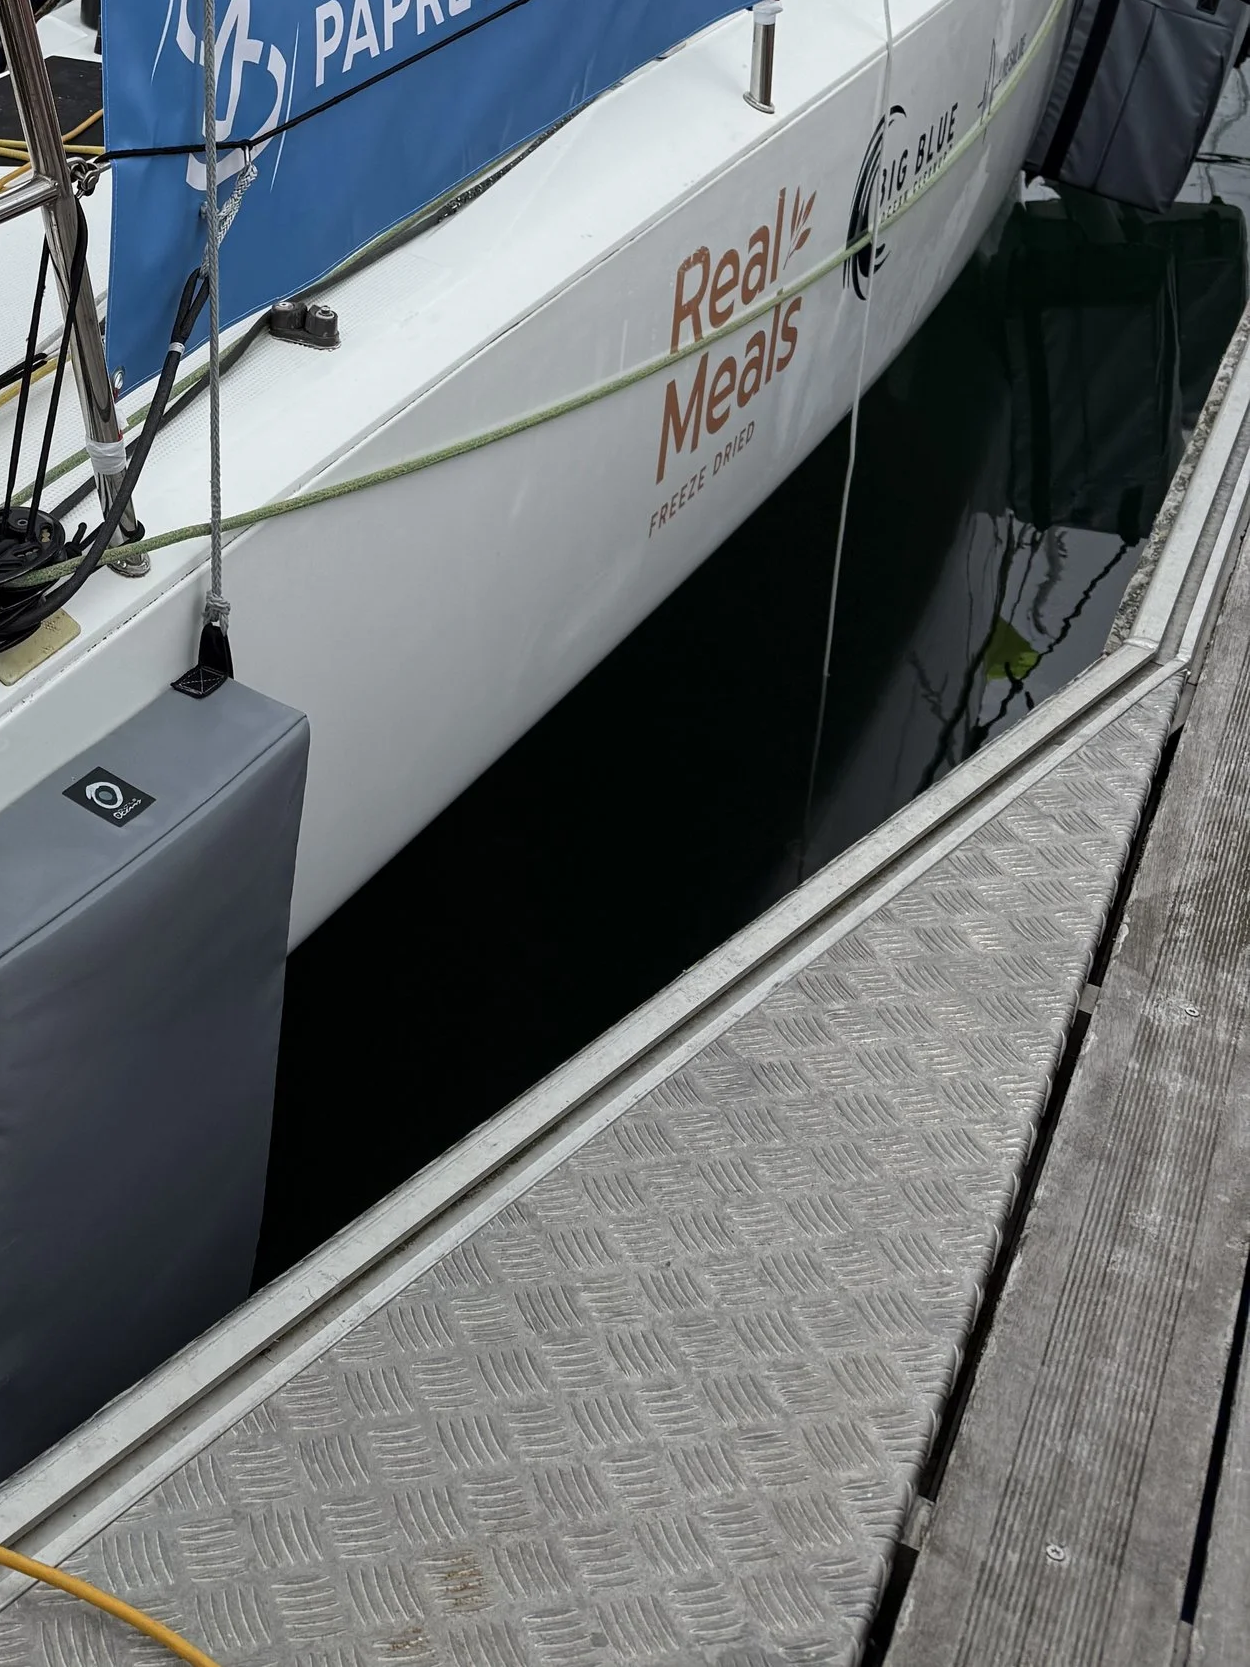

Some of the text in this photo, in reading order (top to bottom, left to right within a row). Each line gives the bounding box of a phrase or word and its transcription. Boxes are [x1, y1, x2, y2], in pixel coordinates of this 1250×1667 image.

[880, 102, 958, 208] BIG BLUE
[670, 186, 786, 354] Real
[656, 288, 802, 485] Meals
[649, 421, 755, 539] FREEZE DRIED
